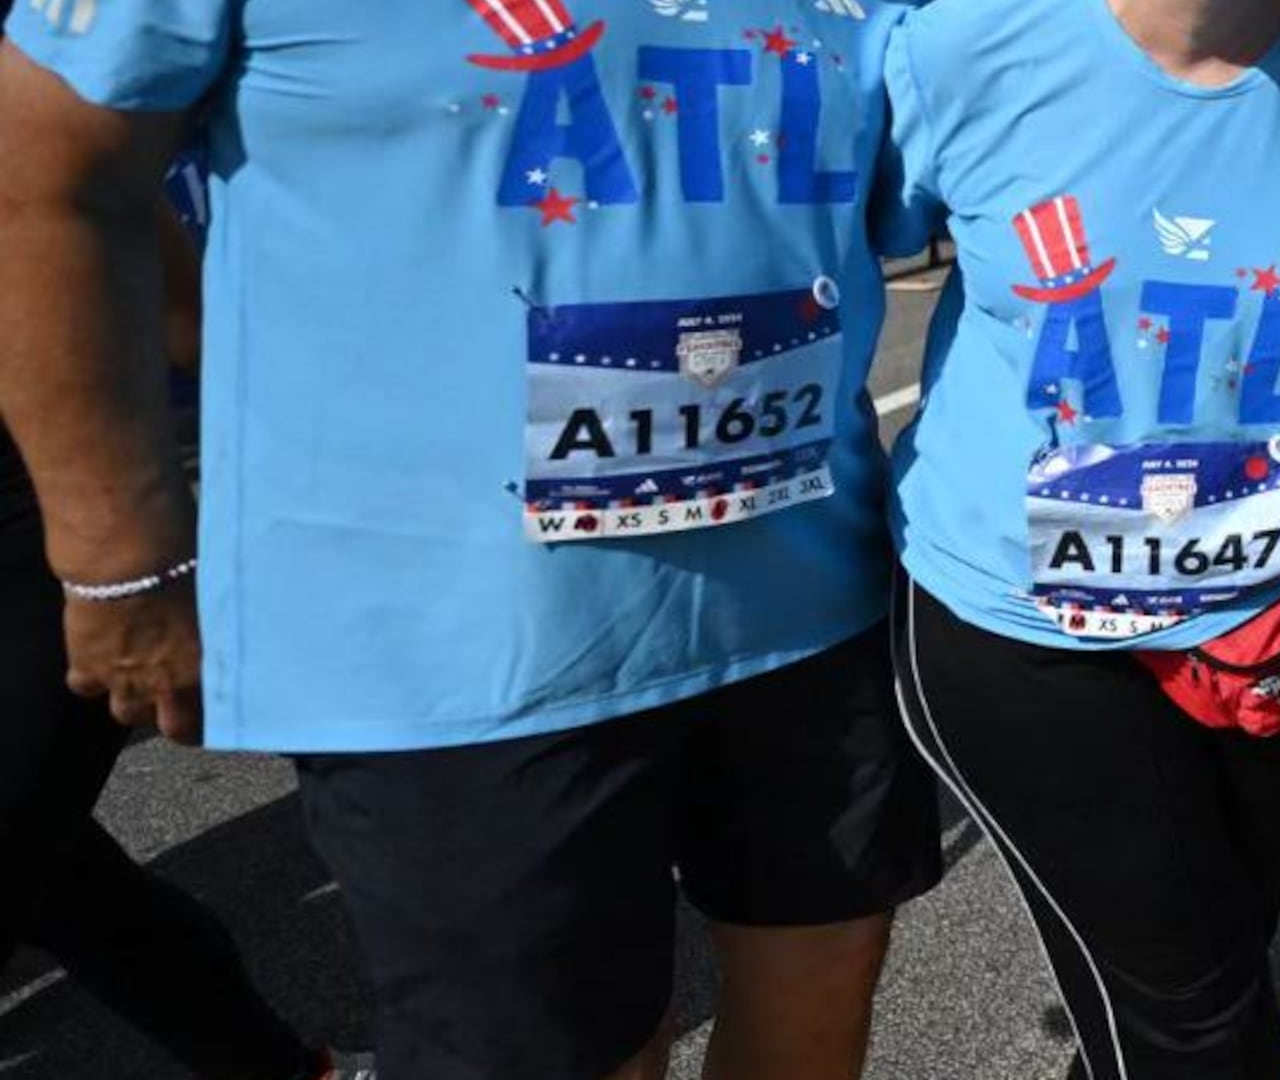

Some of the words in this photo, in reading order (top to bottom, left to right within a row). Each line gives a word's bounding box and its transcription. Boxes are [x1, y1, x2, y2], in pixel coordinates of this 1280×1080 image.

[496, 46, 858, 207] ATL
[547, 383, 823, 460] A11652
[539, 516, 565, 532] W
[616, 513, 642, 529] XS
[658, 510, 670, 525] S
